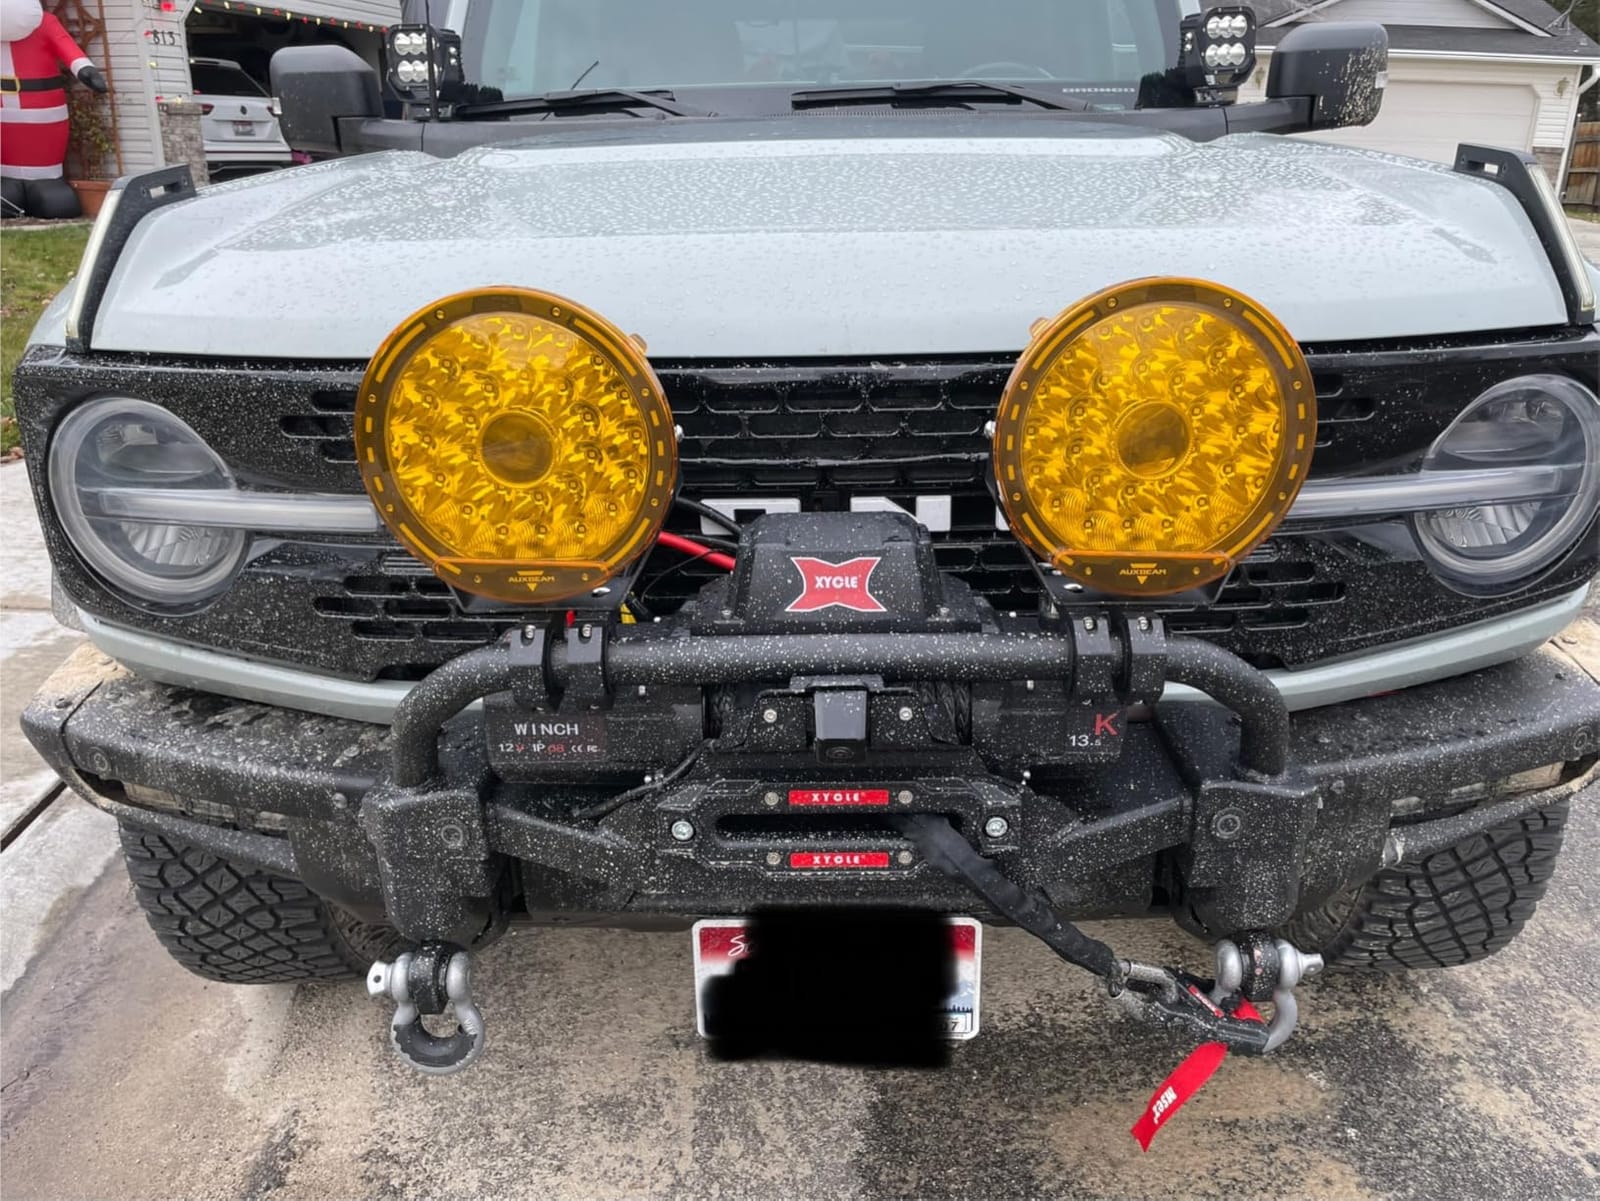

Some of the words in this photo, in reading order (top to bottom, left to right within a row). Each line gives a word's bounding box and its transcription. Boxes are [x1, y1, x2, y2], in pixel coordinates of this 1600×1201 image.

[153, 29, 175, 46] 813
[1119, 568, 1167, 576] AUXBEAM
[508, 575, 556, 583] AUXBEAM
[815, 575, 858, 589] XYCLE
[514, 723, 579, 736] WINCH
[1094, 711, 1120, 736] K
